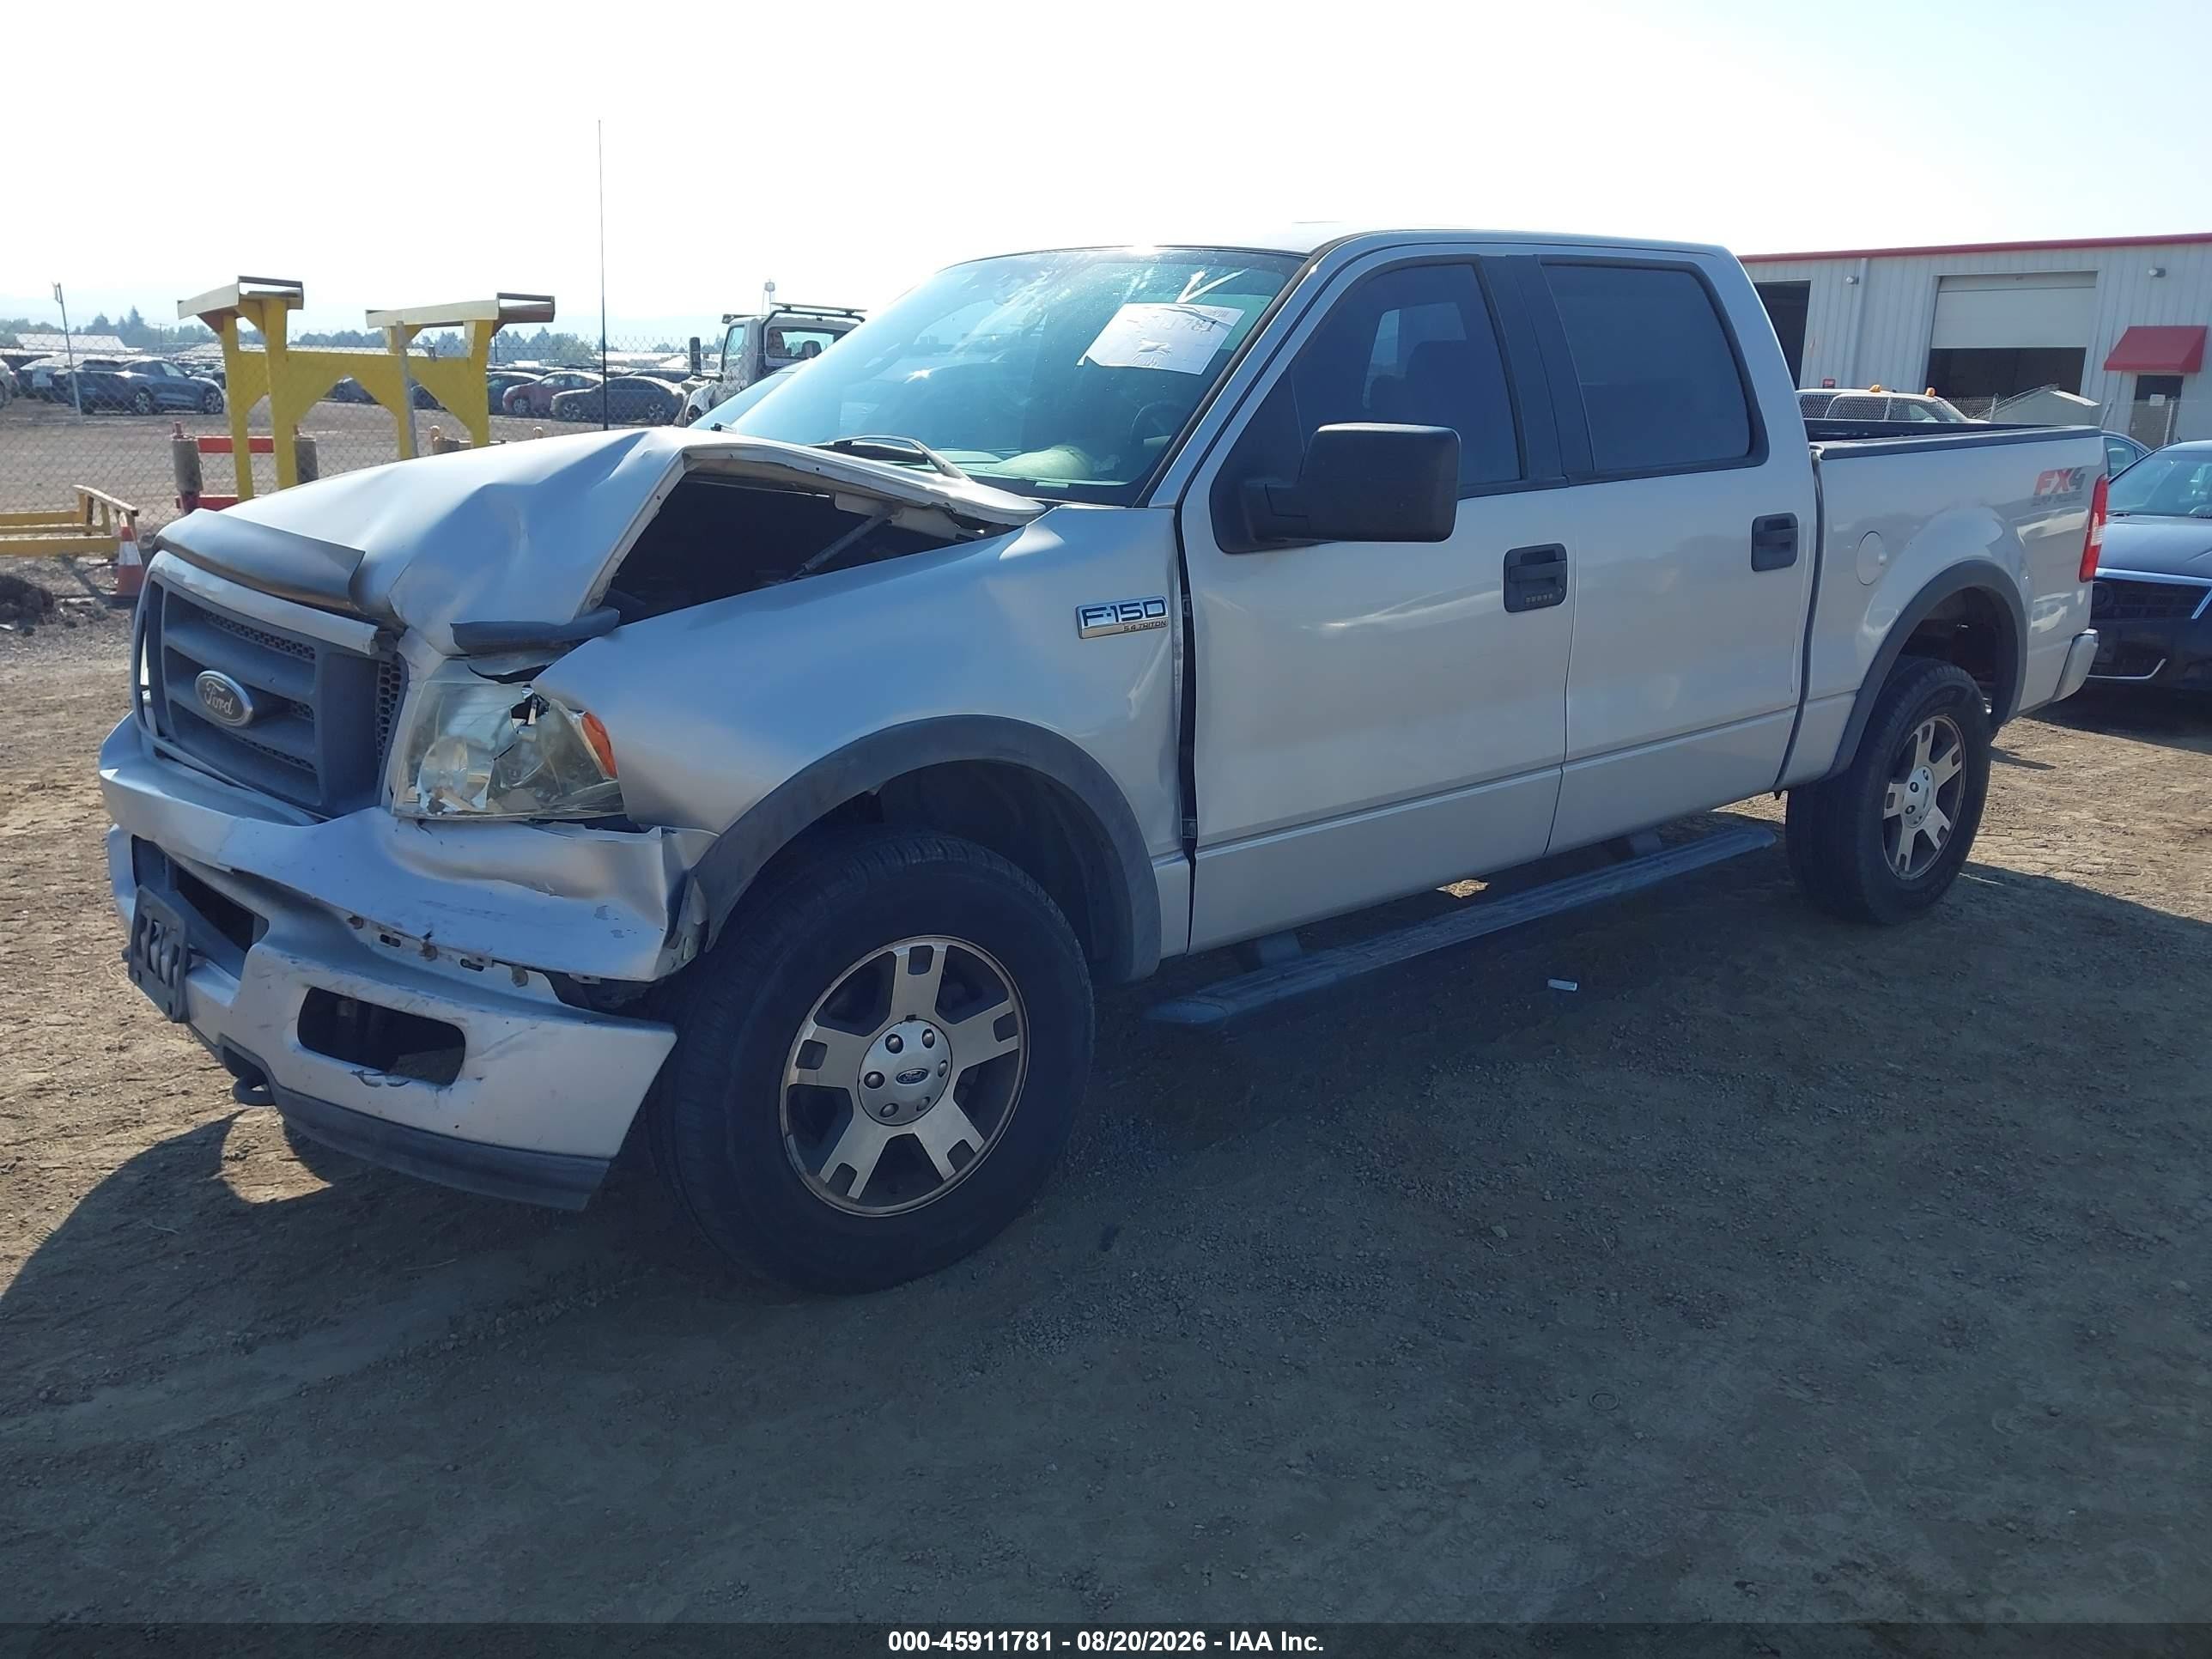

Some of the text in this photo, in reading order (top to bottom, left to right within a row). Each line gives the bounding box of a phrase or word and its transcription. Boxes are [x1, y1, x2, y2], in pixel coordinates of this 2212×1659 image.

[2033, 467, 2086, 495] FX4
[1081, 599, 1166, 627] F-150
[1139, 620, 1167, 629] TRITON
[204, 680, 234, 715] Ford
